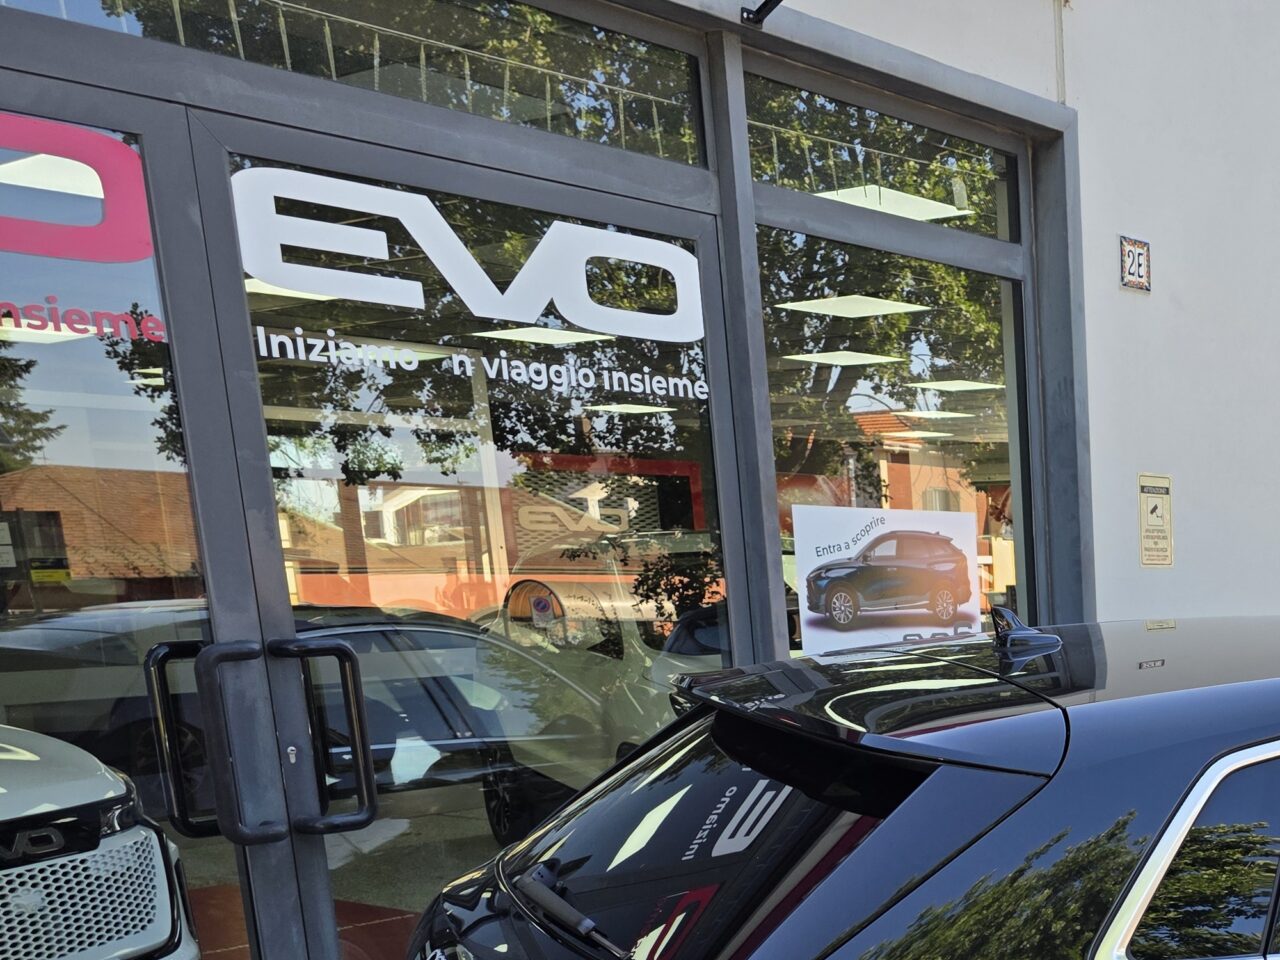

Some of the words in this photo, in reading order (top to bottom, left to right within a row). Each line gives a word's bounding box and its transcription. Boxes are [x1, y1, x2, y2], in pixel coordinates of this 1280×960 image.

[231, 167, 704, 343] EVO
[1127, 249, 1144, 279] 2E
[0, 295, 165, 342] nsieme
[256, 325, 419, 371] Iniziamo
[480, 350, 596, 393] viaggio
[602, 360, 709, 400] insieme
[518, 506, 630, 532] EVO
[815, 545, 843, 557] Entra
[843, 541, 851, 550] a
[851, 516, 886, 546] scoprire
